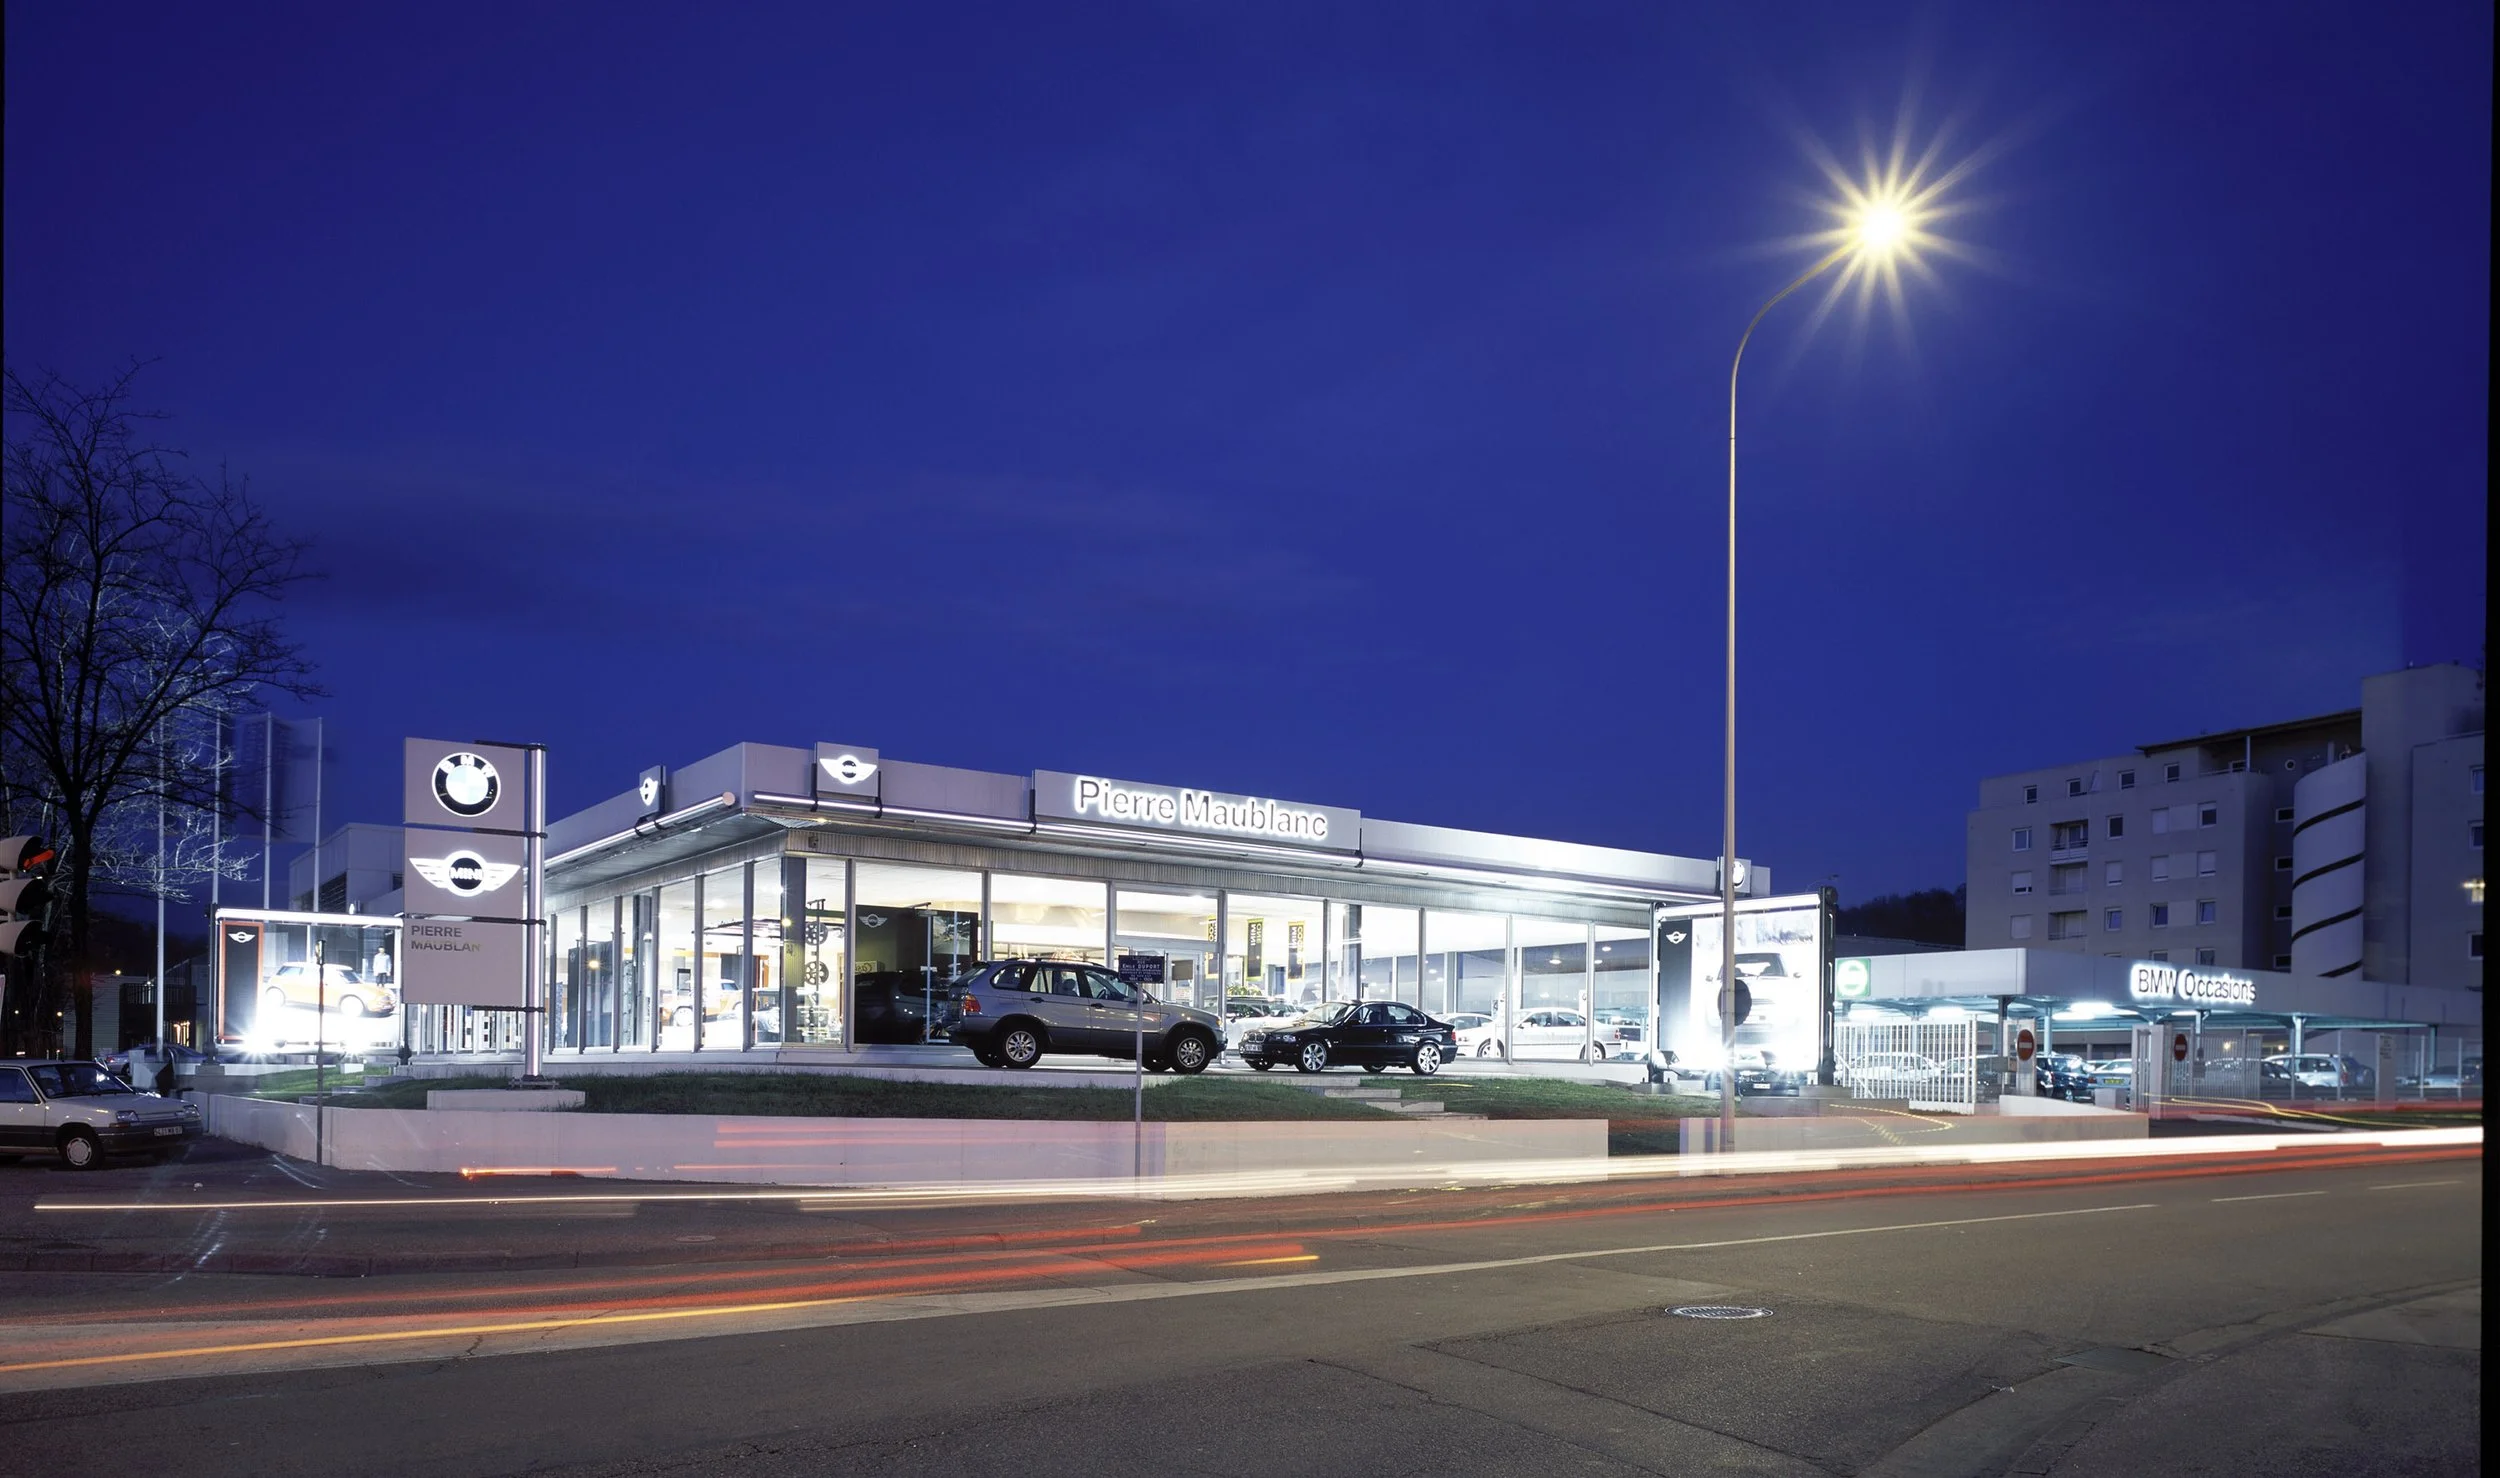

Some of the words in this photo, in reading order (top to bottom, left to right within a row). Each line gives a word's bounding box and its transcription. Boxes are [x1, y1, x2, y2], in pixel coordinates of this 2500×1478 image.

[1079, 780, 1175, 820] Pierre
[1185, 792, 1328, 837] Maublanc
[449, 867, 483, 880] MINI
[411, 925, 463, 938] PIERRE
[2138, 969, 2179, 995] BMW
[2185, 972, 2257, 1001] Occasions
